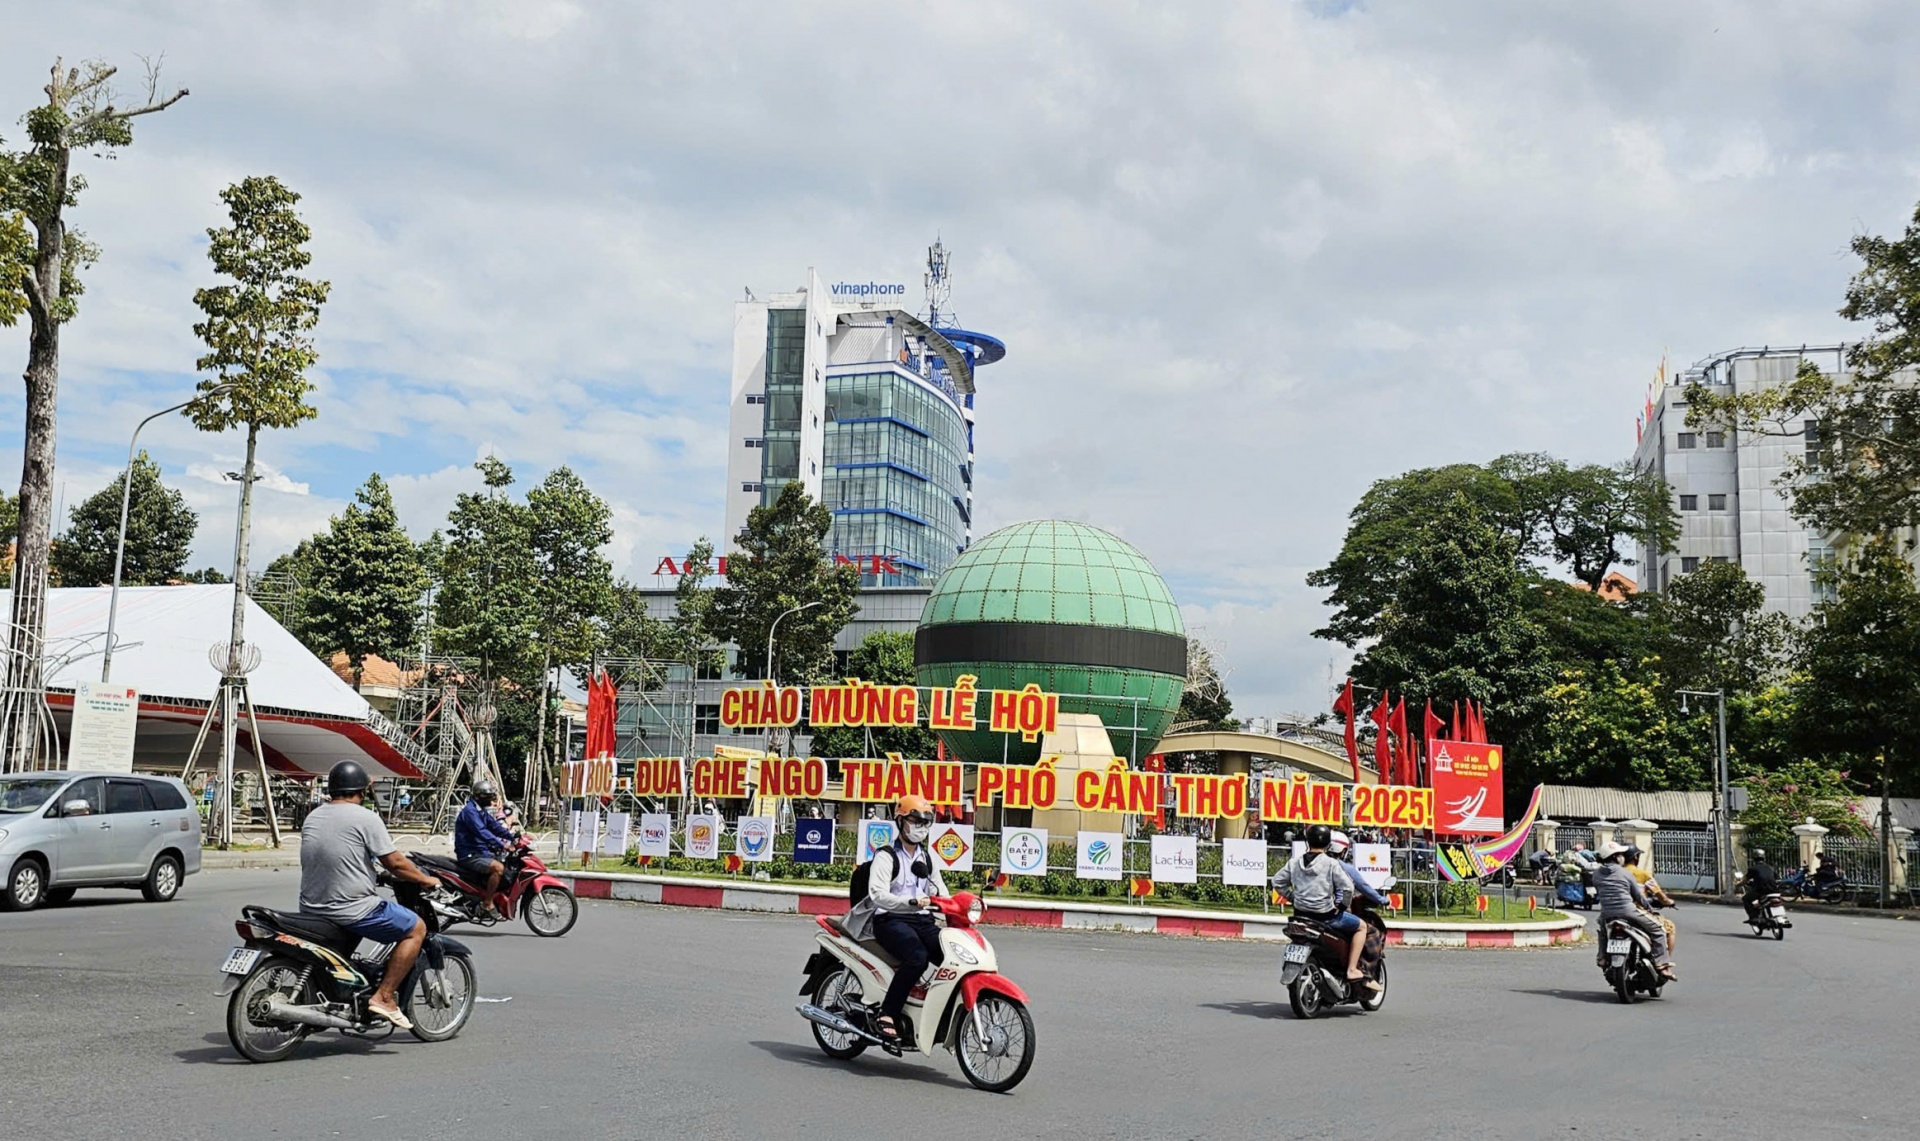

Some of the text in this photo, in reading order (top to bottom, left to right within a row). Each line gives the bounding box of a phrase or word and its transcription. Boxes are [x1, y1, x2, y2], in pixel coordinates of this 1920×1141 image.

[831, 281, 905, 297] vinaphone
[721, 675, 1056, 741] CHÀO MỪNG LỄ HỘI
[636, 759, 684, 796] ĐUA
[693, 759, 747, 797] GHE
[758, 759, 824, 797] NGO
[842, 754, 962, 803] THÀNH
[978, 758, 1057, 809] PHỐ
[1075, 759, 1156, 813] CẦN
[1174, 774, 1246, 817] THƠ
[1263, 775, 1342, 823] NĂM
[1354, 786, 1435, 827] 2025!
[1009, 847, 1040, 855] BAYER
